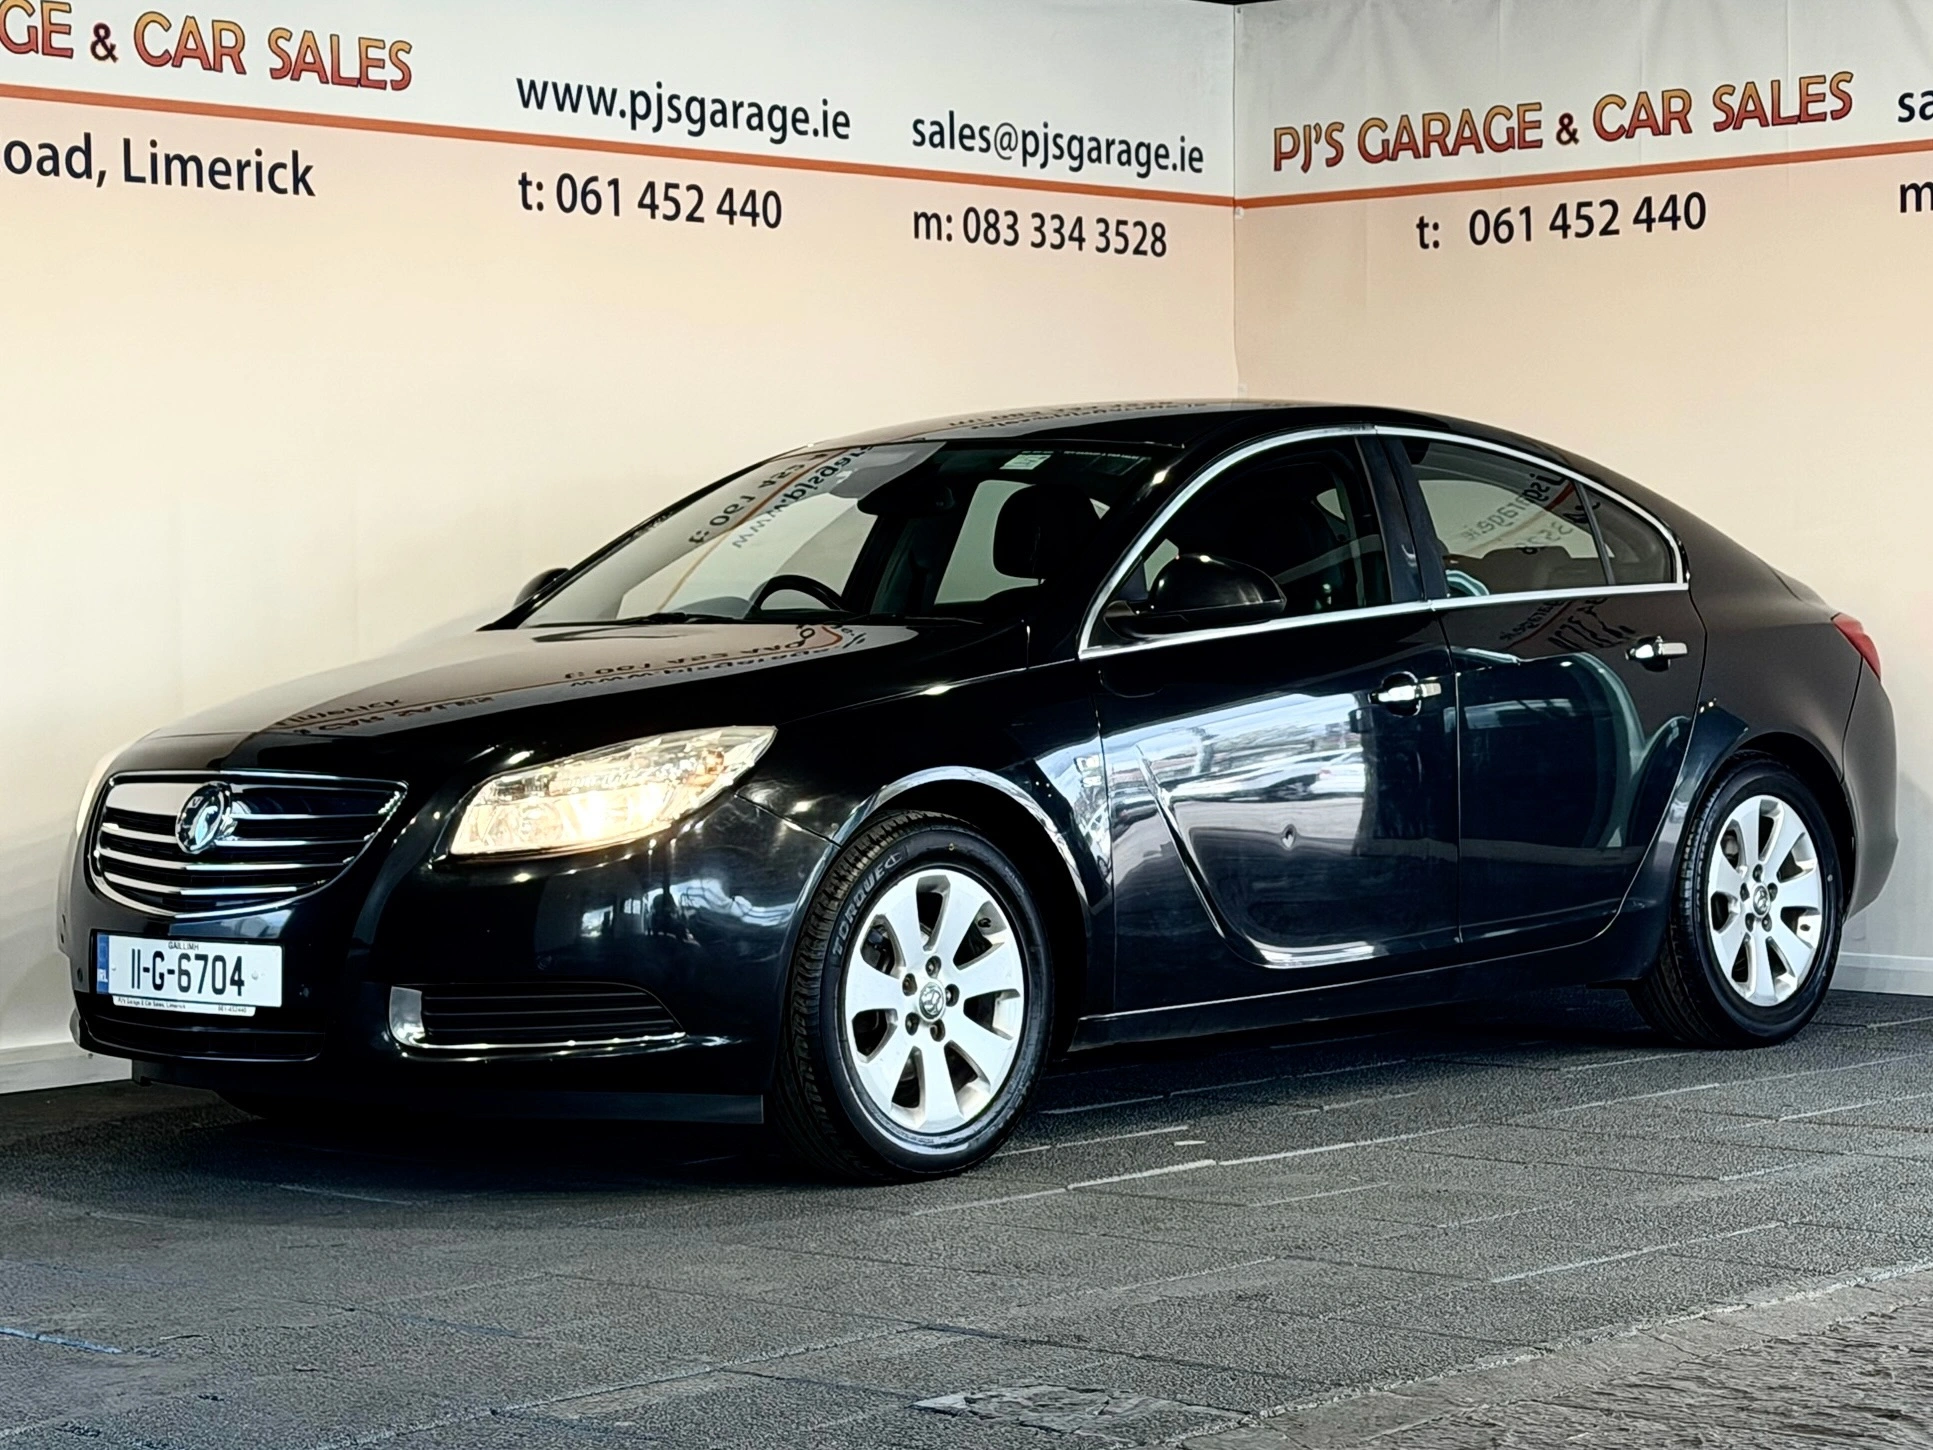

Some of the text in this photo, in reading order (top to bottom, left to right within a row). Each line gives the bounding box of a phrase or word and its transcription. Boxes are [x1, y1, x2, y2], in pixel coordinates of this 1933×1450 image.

[0, 0, 413, 91] GE & CAR SALES
[516, 77, 851, 145] www.pjsgarage.ie
[912, 109, 1204, 179] sales@pjsgarage.ie
[1273, 70, 1854, 174] PJ'S GARAGE & CAR SALES
[3, 131, 316, 197] oad, Limerick
[518, 171, 782, 229] t: 061 452 440
[913, 206, 1167, 258] m: 083 334 3528
[1416, 191, 1707, 250] t: 061 452 440
[832, 862, 886, 956] TORQUE
[131, 947, 246, 997] 11-G-6704
